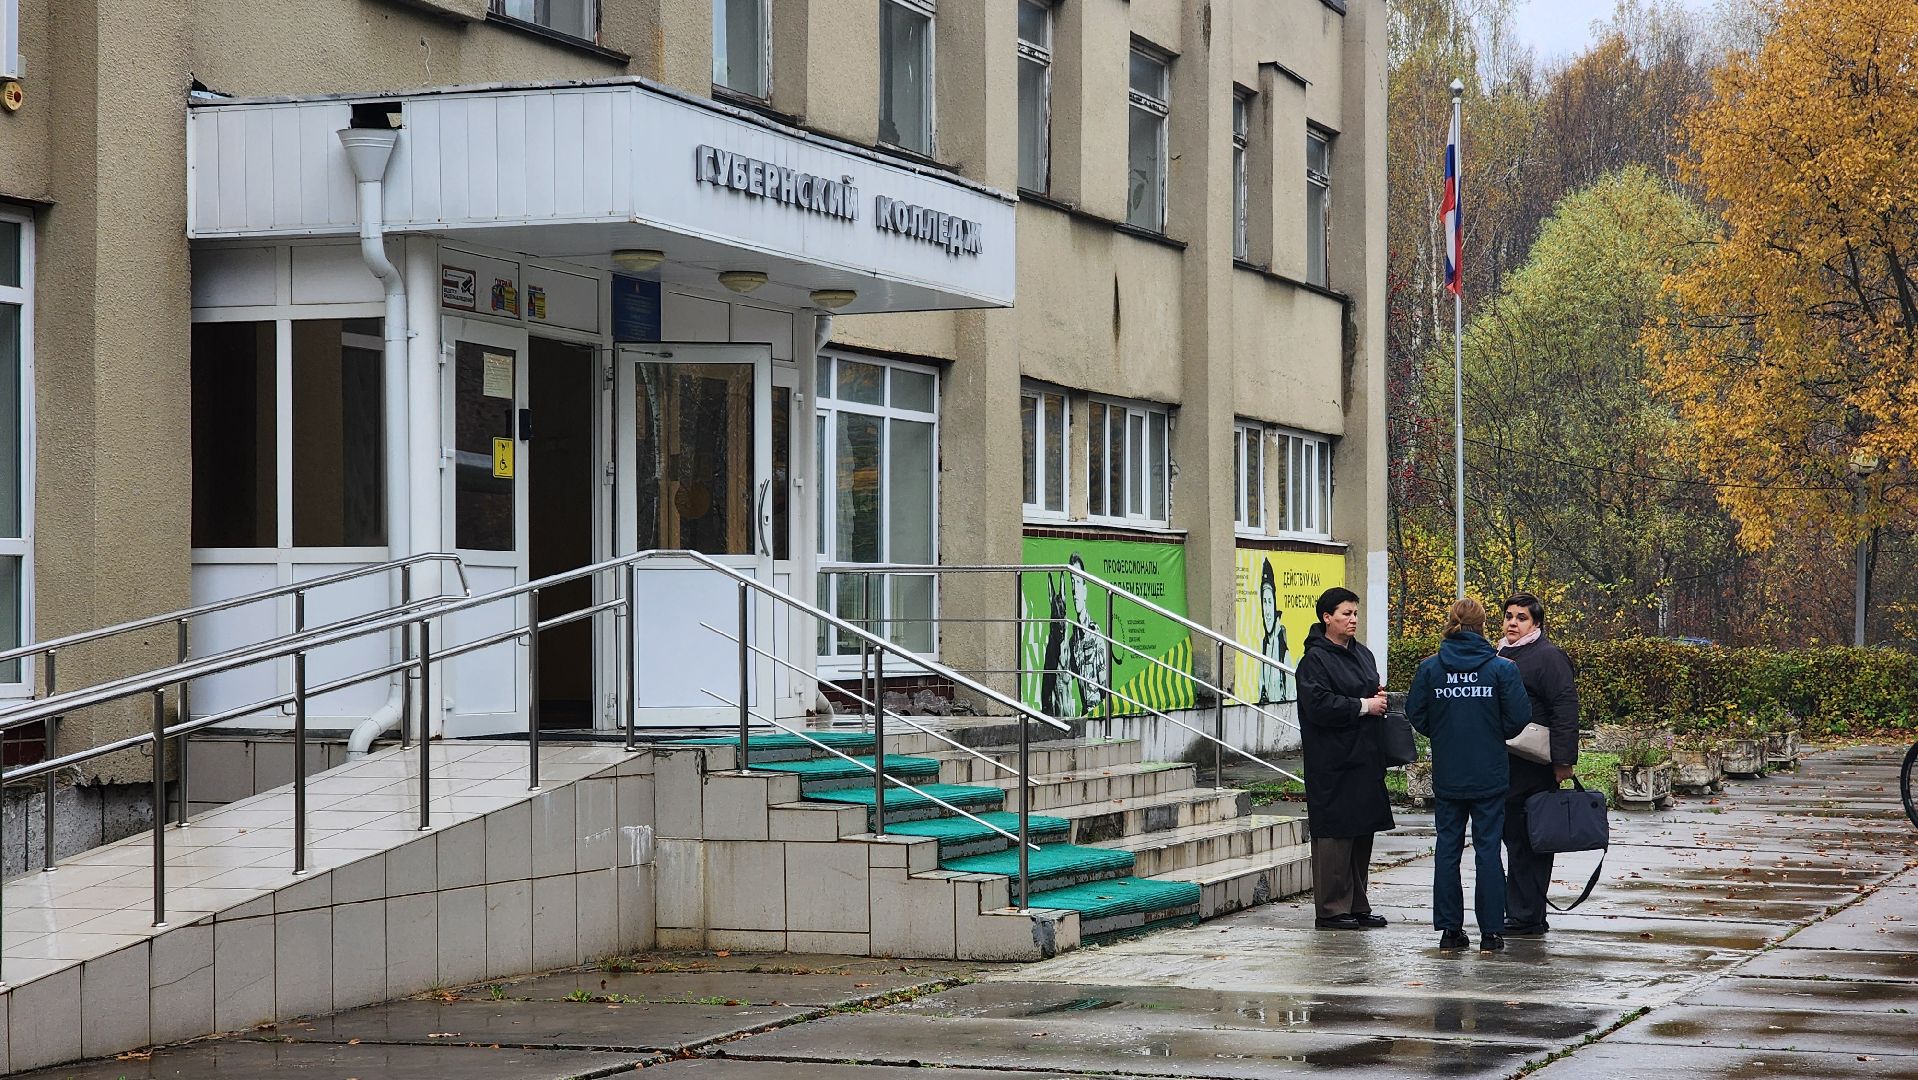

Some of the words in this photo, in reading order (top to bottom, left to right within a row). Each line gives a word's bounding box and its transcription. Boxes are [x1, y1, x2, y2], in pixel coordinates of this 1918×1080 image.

[696, 144, 859, 221] ГУБЕРНСКИЙ
[876, 194, 983, 255] КОЛЛЕДЖ
[1283, 568, 1310, 588] ДЕЙСТВУЙ
[1310, 572, 1321, 587] КАК
[1135, 582, 1165, 599] БУДУЩЕЕ!
[1283, 594, 1320, 609] ПРОФЕССИОН
[1446, 672, 1478, 684] МЧС
[1434, 686, 1493, 699] РОССИИ
